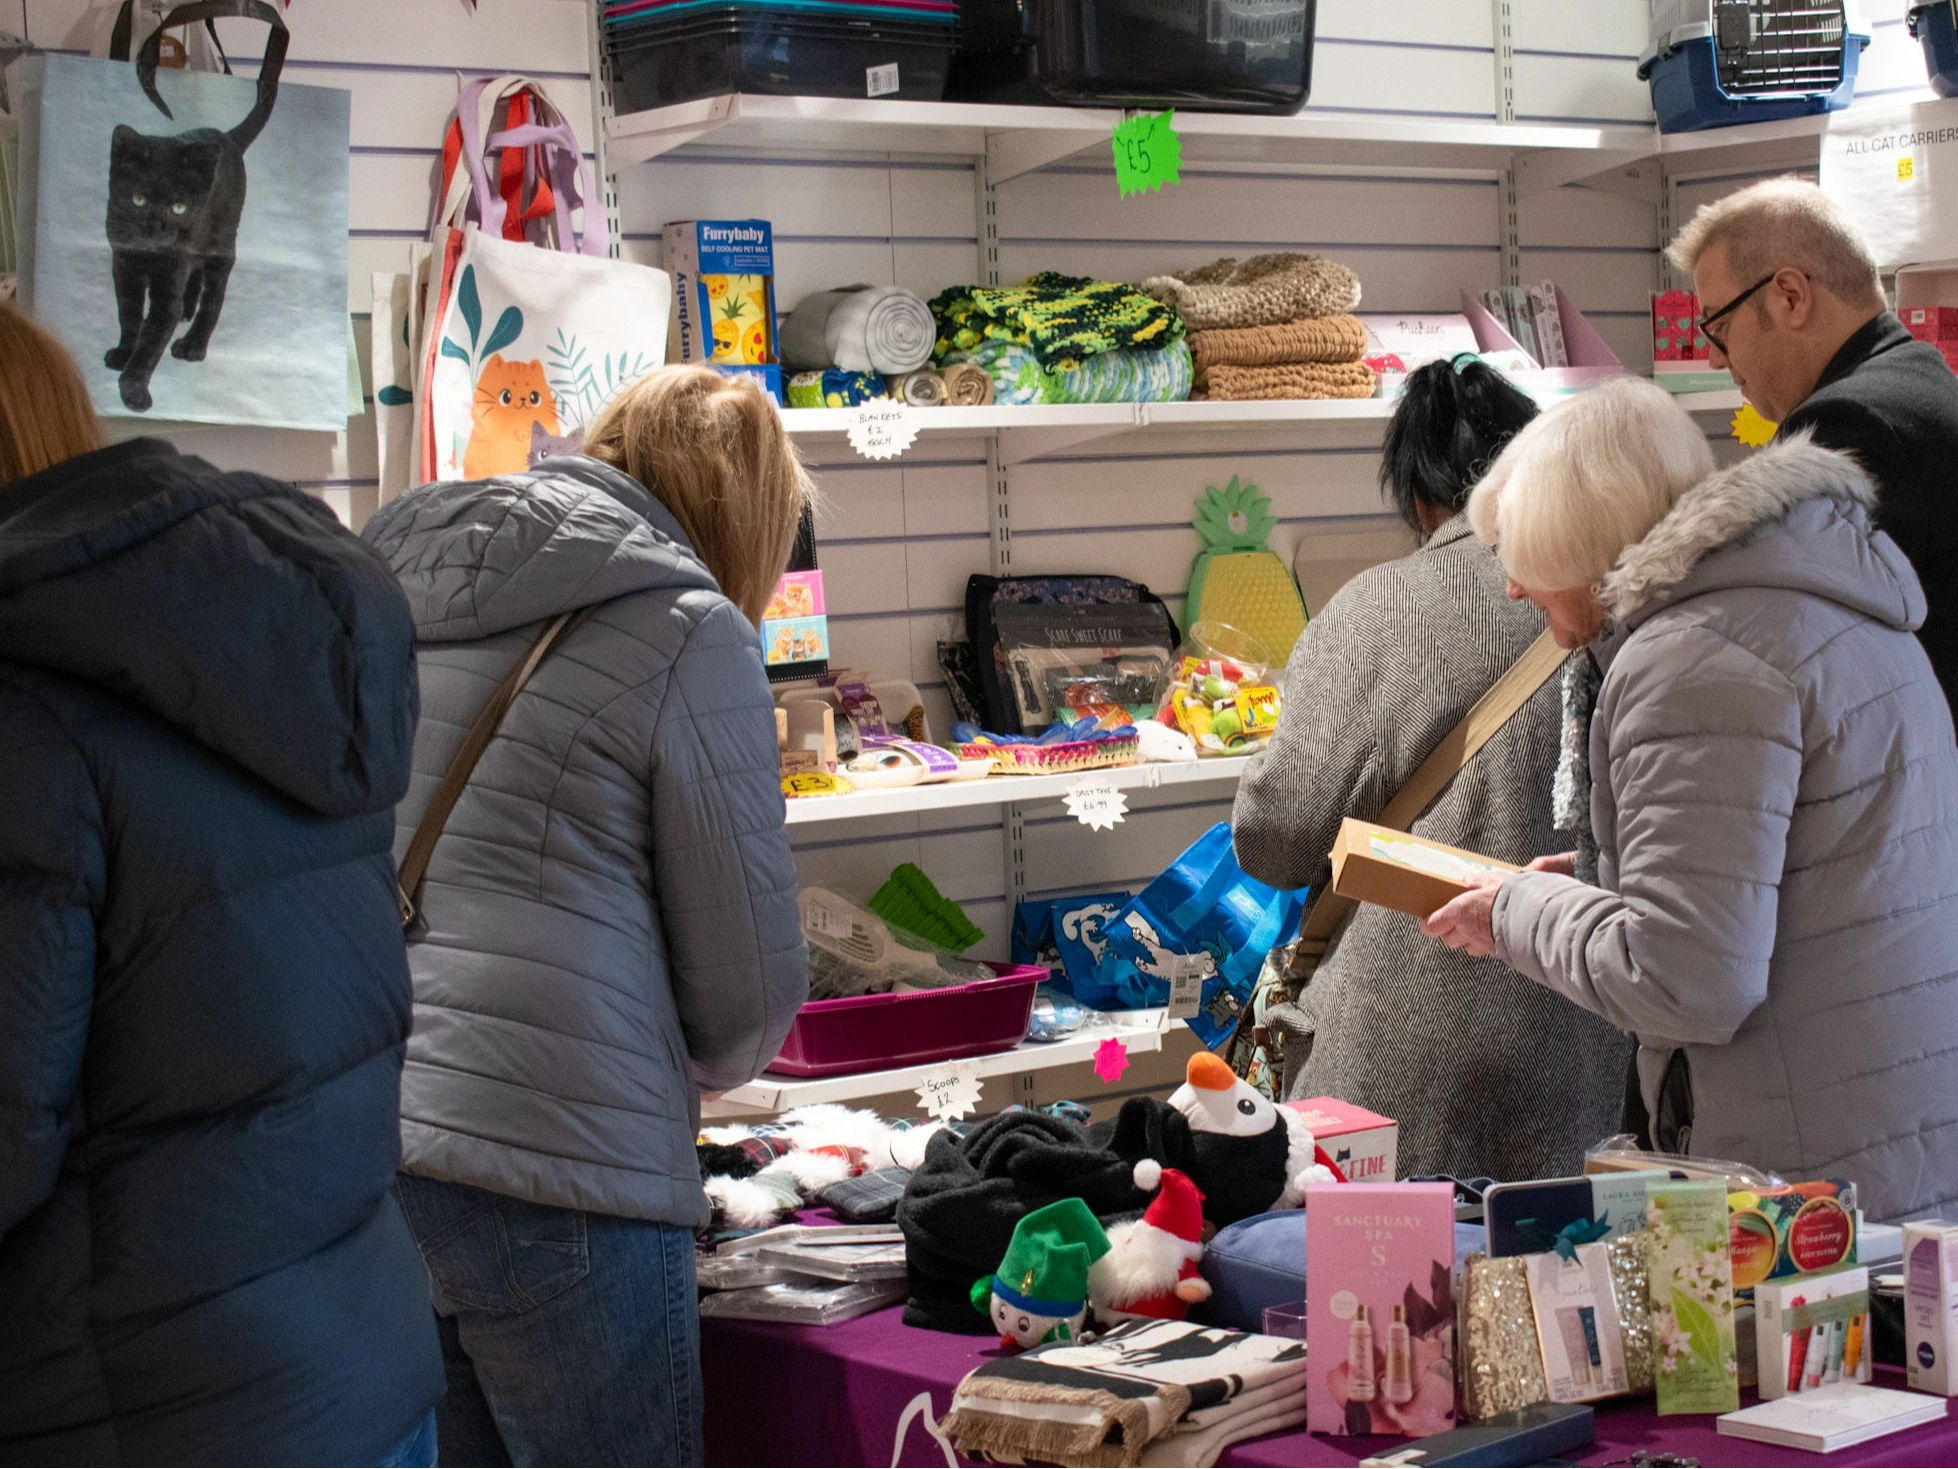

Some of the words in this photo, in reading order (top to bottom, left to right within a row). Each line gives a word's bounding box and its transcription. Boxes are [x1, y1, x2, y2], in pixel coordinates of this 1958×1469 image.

[1846, 140, 1870, 156] ALL
[1871, 136, 1896, 153] CAT
[1127, 138, 1151, 174] £5
[1898, 162, 1913, 177] £5
[703, 226, 764, 244] Furrybaby
[701, 245, 716, 253] SELF
[716, 245, 742, 253] COOLING
[743, 245, 755, 253] PET
[859, 411, 902, 424] BLANKETS
[927, 1076, 960, 1092] Scoops
[937, 1092, 954, 1108] £2
[1348, 1154, 1387, 1180] FINE
[1602, 1191, 1629, 1200] LAURA
[1333, 1215, 1422, 1228] SANCTUARY
[1365, 1229, 1393, 1241] SPA
[1796, 1232, 1842, 1246] Strawberry
[1371, 1245, 1386, 1266] S
